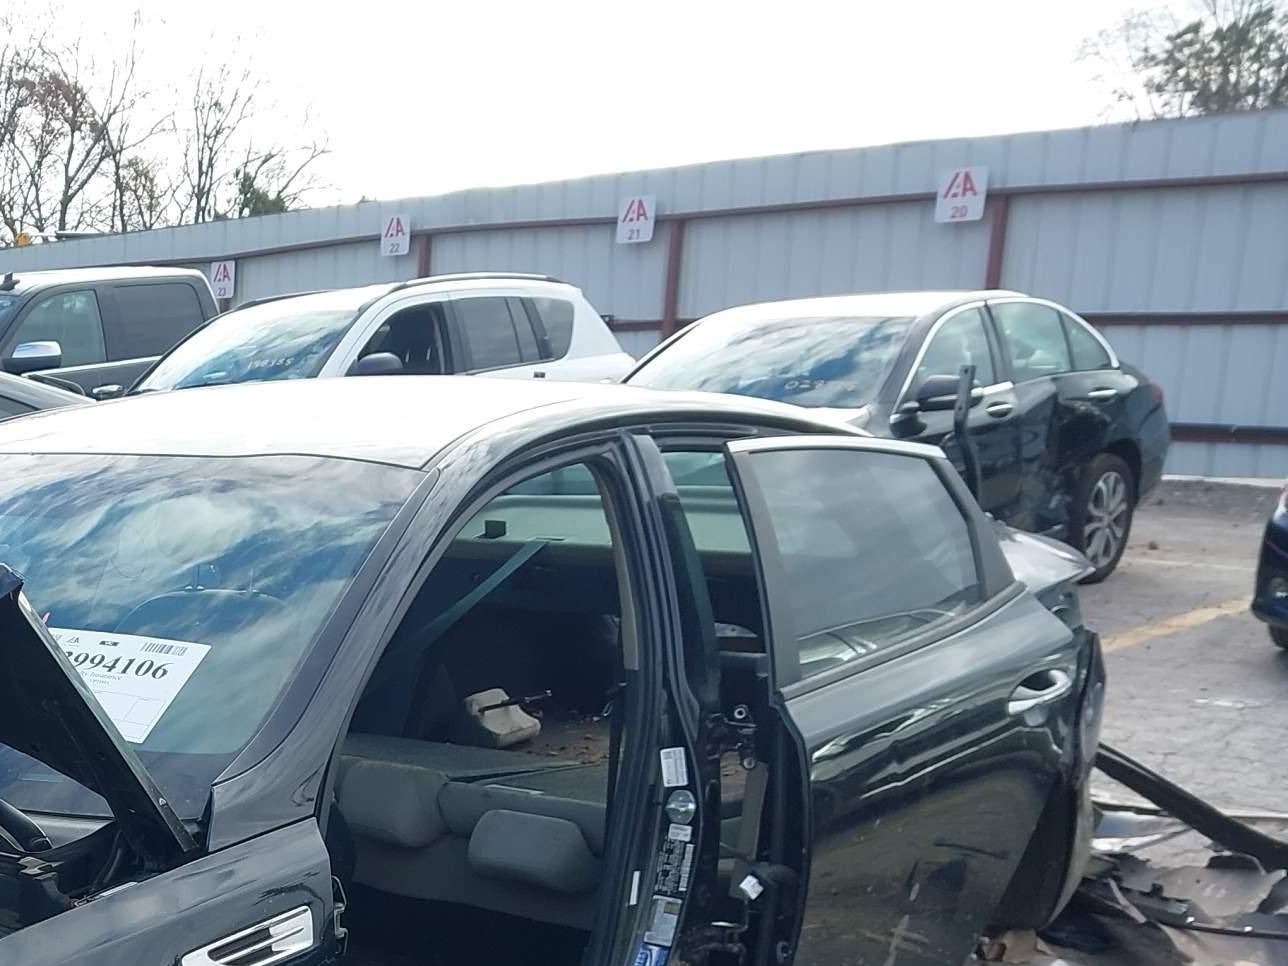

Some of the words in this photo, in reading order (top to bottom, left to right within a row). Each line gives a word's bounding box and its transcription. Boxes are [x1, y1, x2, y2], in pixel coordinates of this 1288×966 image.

[950, 204, 969, 219] 20
[627, 228, 641, 240] 21
[389, 242, 401, 254] 22
